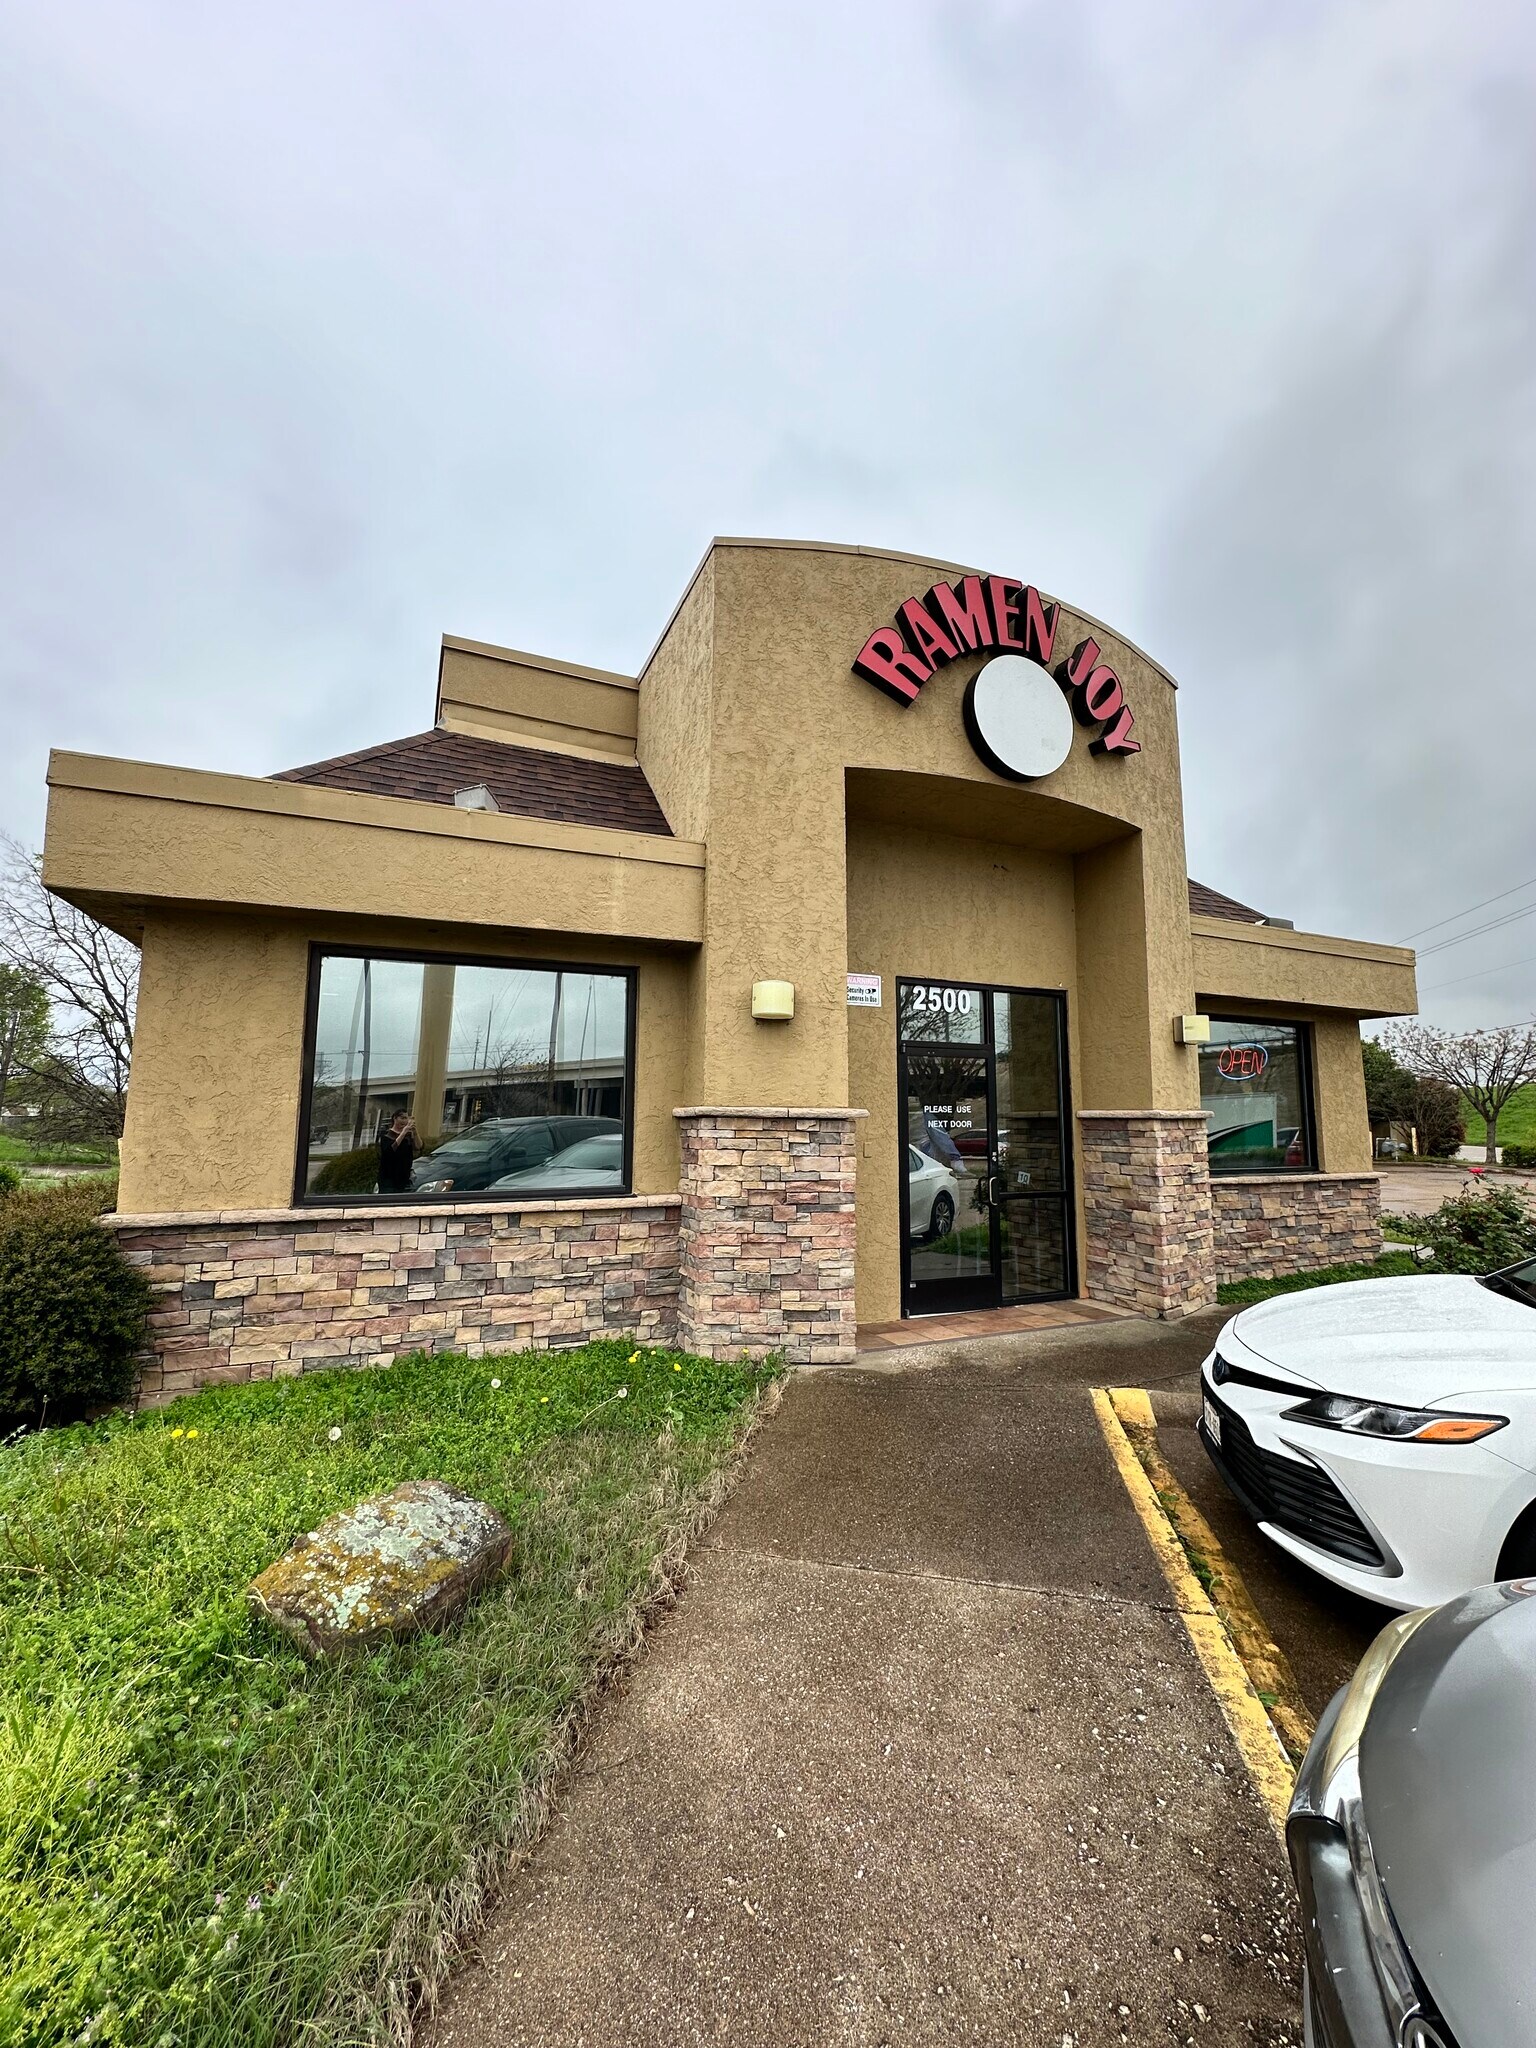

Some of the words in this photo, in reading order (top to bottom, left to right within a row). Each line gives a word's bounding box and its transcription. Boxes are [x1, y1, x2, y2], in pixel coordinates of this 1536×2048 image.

[851, 575, 1061, 708] RAMEN
[1054, 637, 1141, 756] JOY
[847, 986, 864, 995] Security
[913, 986, 971, 1013] 2500
[1219, 1047, 1265, 1074] OPEN
[924, 1105, 953, 1113] PLEASE
[956, 1105, 972, 1113] USE
[928, 1120, 948, 1128] NEXT
[950, 1120, 972, 1128] DOOR
